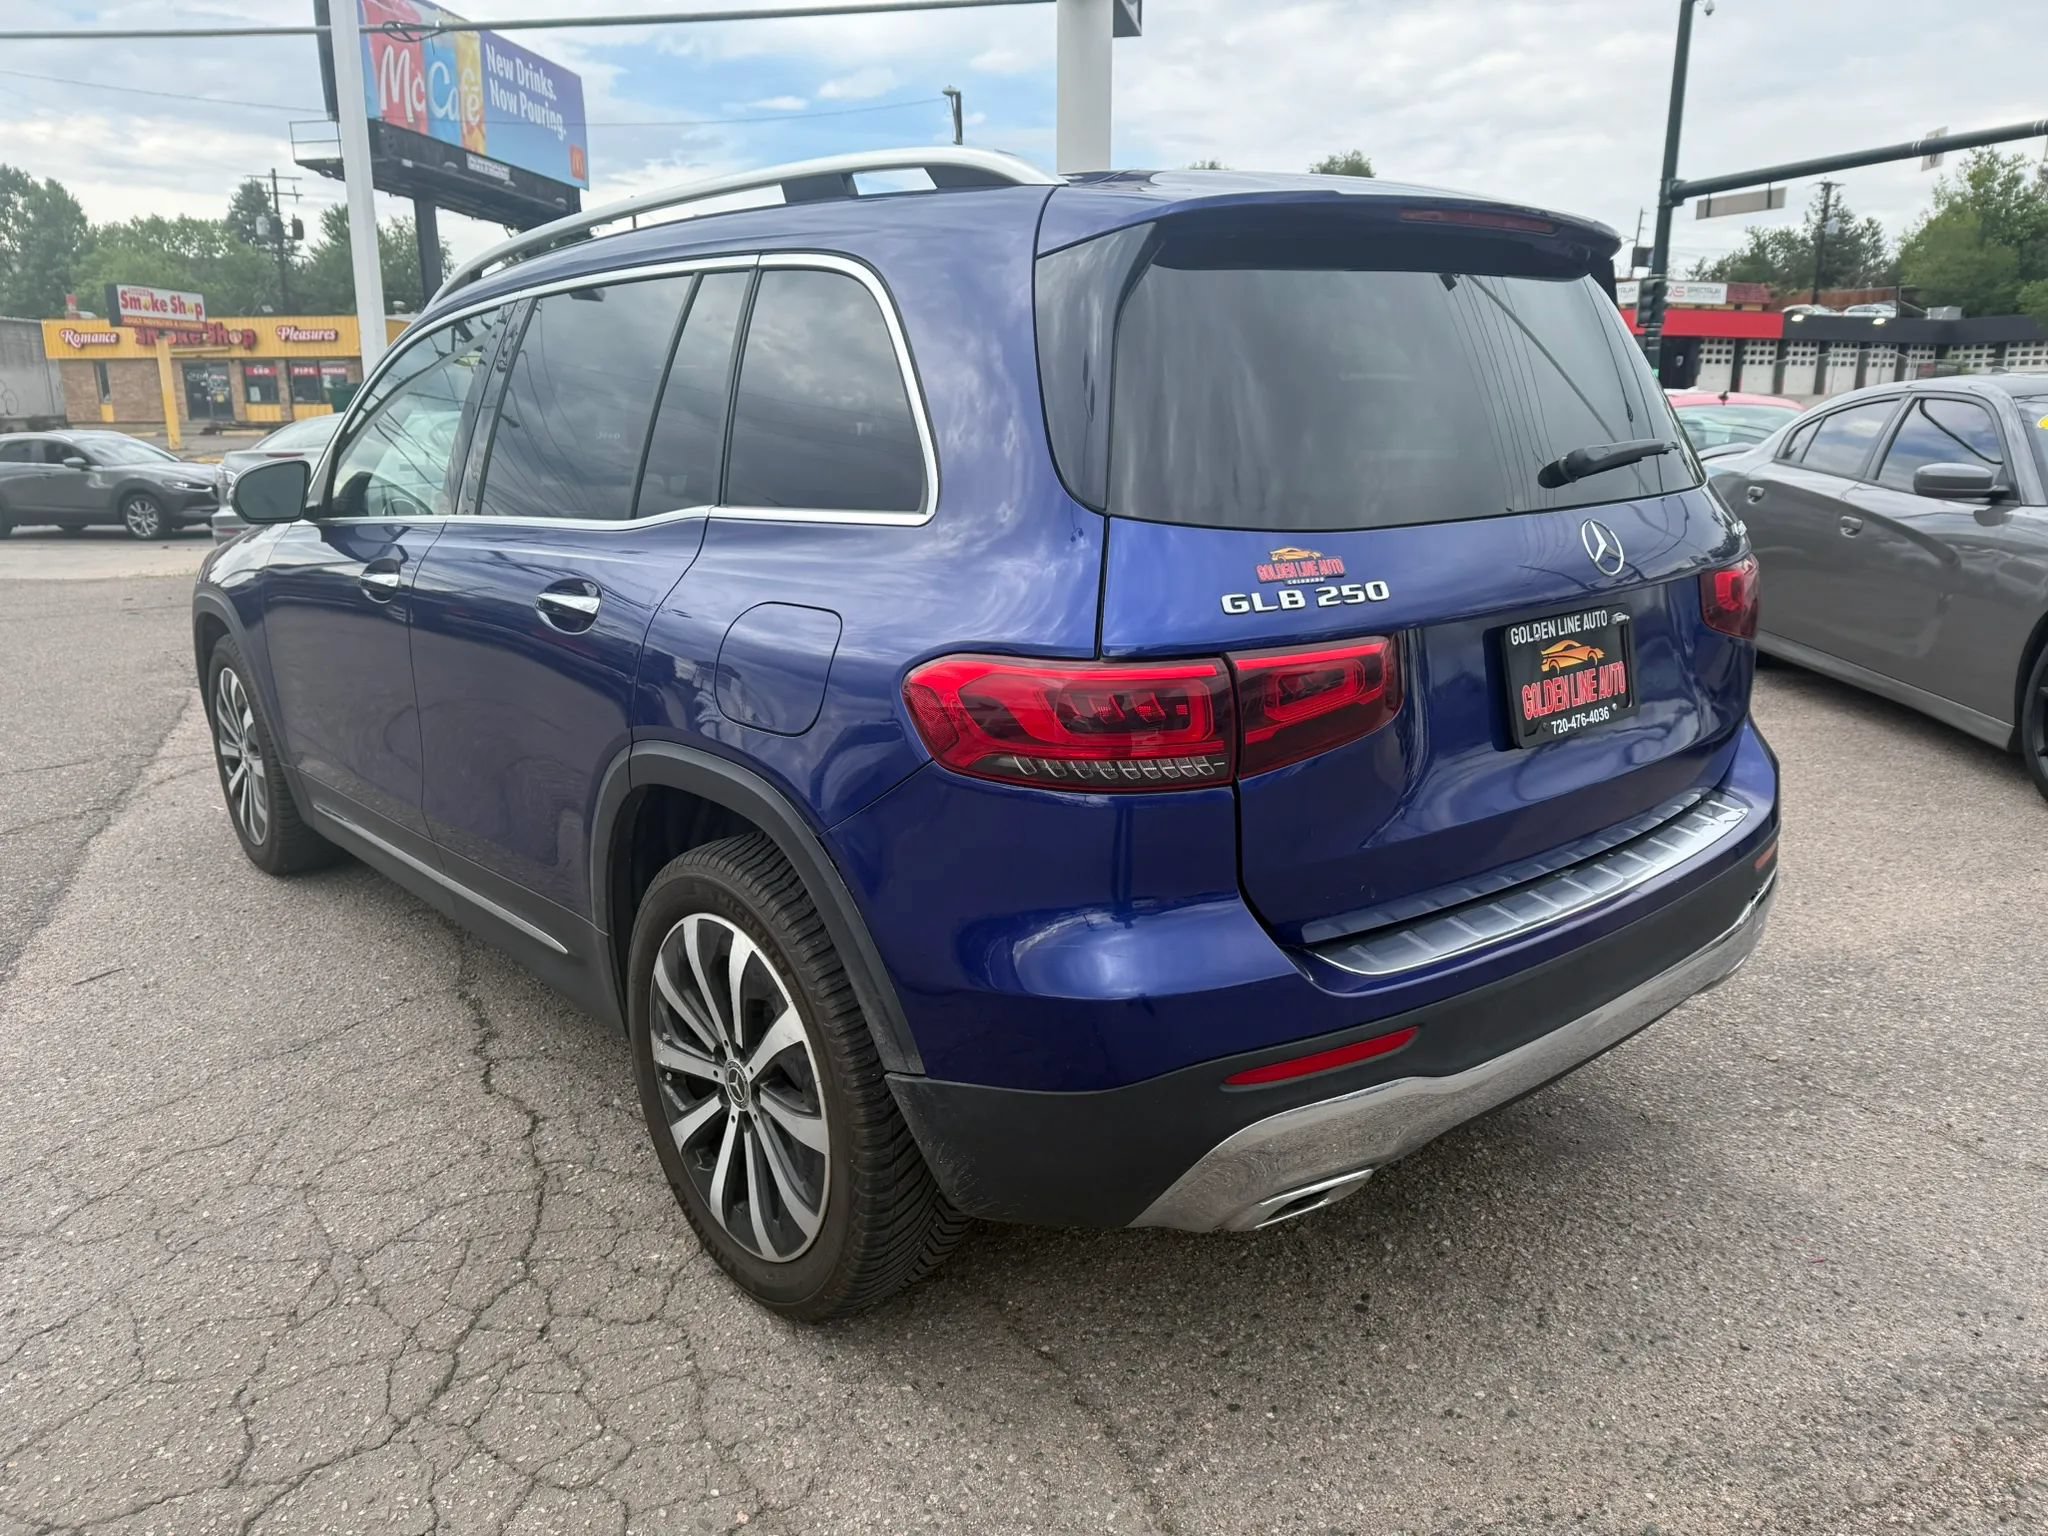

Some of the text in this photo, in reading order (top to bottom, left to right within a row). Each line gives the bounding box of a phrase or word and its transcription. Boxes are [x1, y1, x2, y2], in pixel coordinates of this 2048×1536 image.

[485, 43, 557, 101] New Drinks.
[489, 79, 568, 141] Now Pouring.
[120, 289, 203, 321] Smoke Shop
[60, 328, 118, 348] Romance
[276, 326, 338, 342] Pleasures
[1256, 558, 1345, 582] GOLDEN LINE AUTO
[1221, 580, 1391, 614] GLB 250
[1510, 609, 1608, 645] GOLDEN LINE AUTO
[1521, 661, 1626, 720] GOLDEN LINE AUTO
[1550, 706, 1610, 735] 720-476-4036
